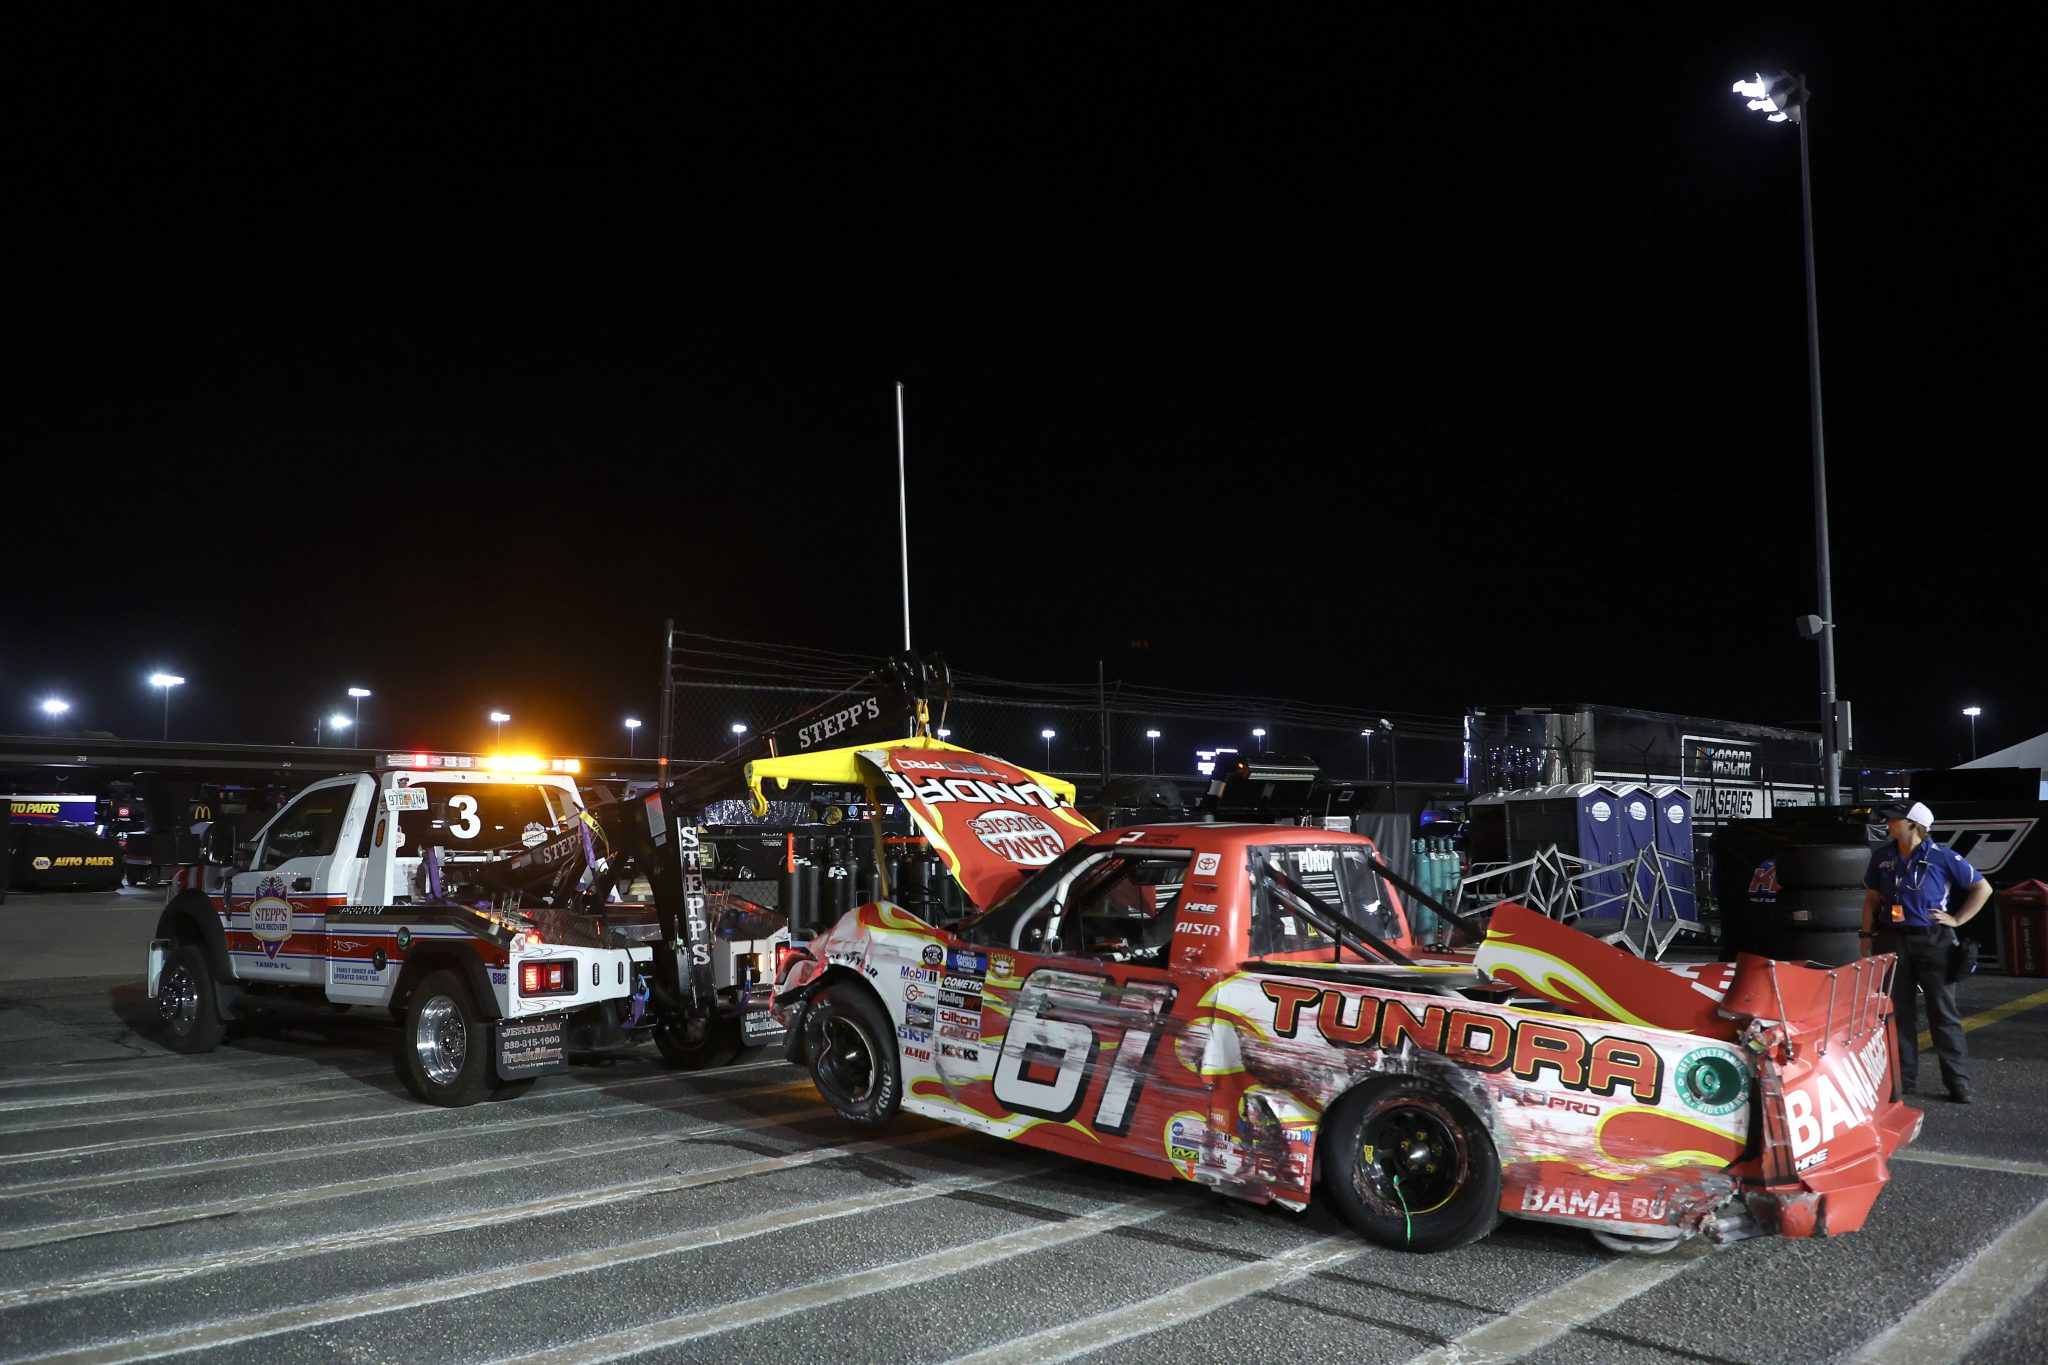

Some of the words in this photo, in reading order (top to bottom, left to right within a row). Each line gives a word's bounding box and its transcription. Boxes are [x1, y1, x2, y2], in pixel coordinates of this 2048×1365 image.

[799, 697, 880, 749] STEPP'S
[26, 803, 61, 814] PARTS
[1717, 791, 1753, 816] SERIES
[448, 794, 482, 840] 3
[966, 813, 1044, 837] BUGGIES
[985, 834, 1066, 862] BAMA
[53, 857, 82, 867] AUTO
[85, 857, 115, 867] PARTS
[1298, 848, 1334, 873] PURDY
[255, 907, 288, 922] STEPP'S
[1184, 902, 1218, 914] HRE
[255, 961, 279, 969] TAMPA
[900, 965, 927, 980] Mobil
[943, 976, 983, 991] COMETIC
[939, 991, 964, 1007] Holley
[940, 1010, 978, 1027] tilton
[503, 1035, 561, 1050] 888-815-1900
[1261, 980, 1665, 1106] TUNDRA
[1678, 1058, 1691, 1073] GET
[1547, 1096, 1601, 1118] PRO
[1784, 1051, 1879, 1159] BAMA
[1795, 1149, 1828, 1173] HRE
[1520, 1184, 1623, 1220] BAMA
